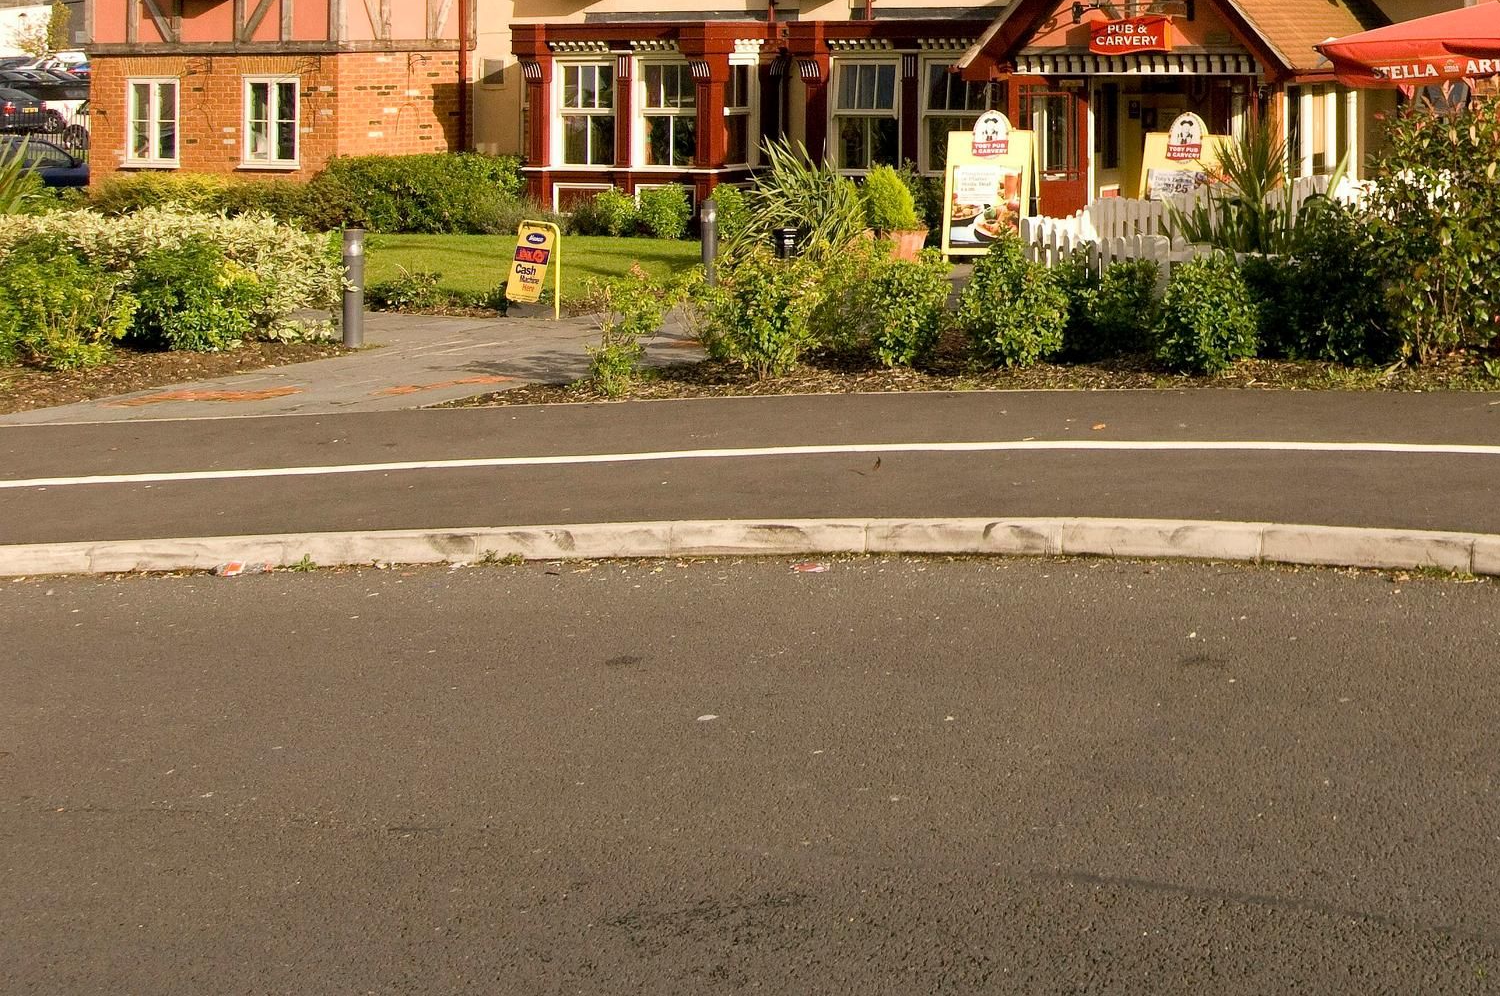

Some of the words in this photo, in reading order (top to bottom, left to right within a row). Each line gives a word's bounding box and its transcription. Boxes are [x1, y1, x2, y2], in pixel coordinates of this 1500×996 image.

[1107, 24, 1134, 34] PUB
[1137, 24, 1148, 34] &
[1096, 35, 1158, 46] CARVERY
[1372, 63, 1439, 80] STELLA
[515, 263, 537, 276] Cash
